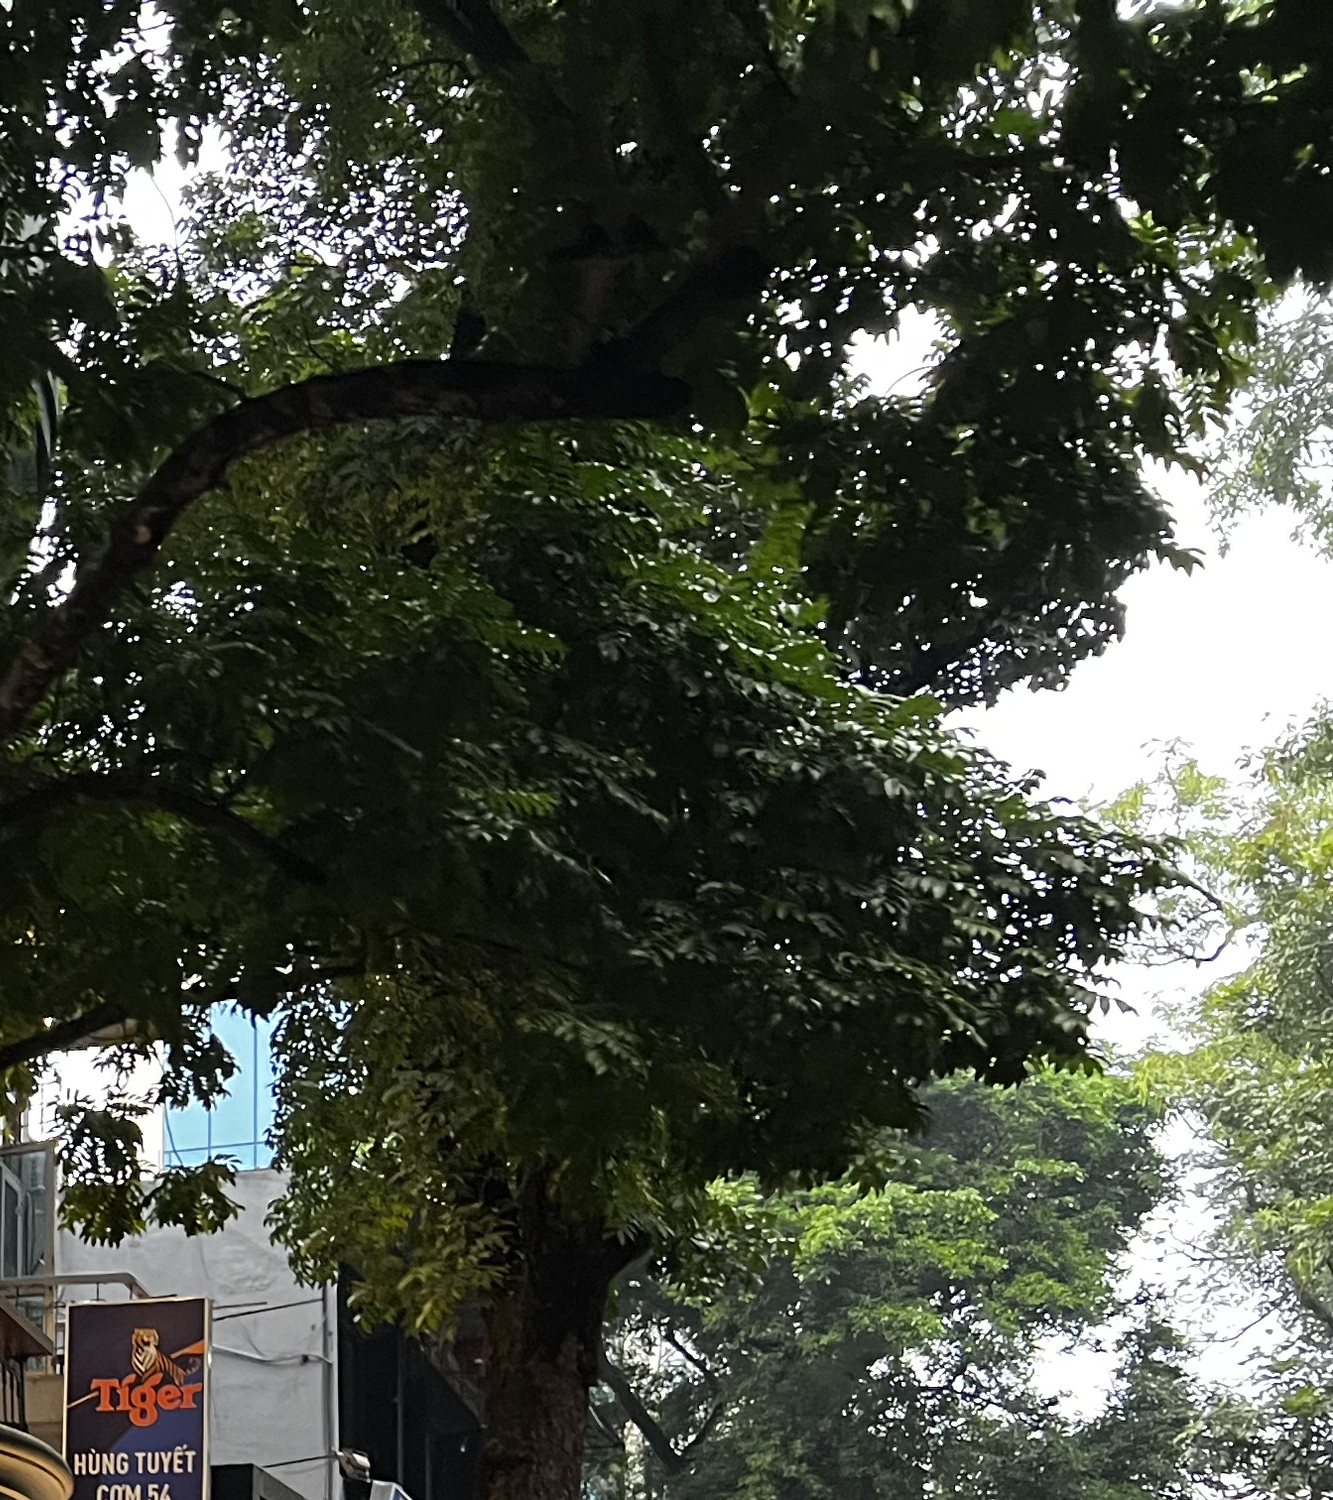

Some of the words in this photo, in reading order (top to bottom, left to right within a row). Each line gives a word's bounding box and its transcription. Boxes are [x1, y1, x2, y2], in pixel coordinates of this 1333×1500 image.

[90, 1373, 203, 1427] Tiger
[74, 1448, 129, 1475] HÙNG
[134, 1444, 196, 1474] TUYẾT
